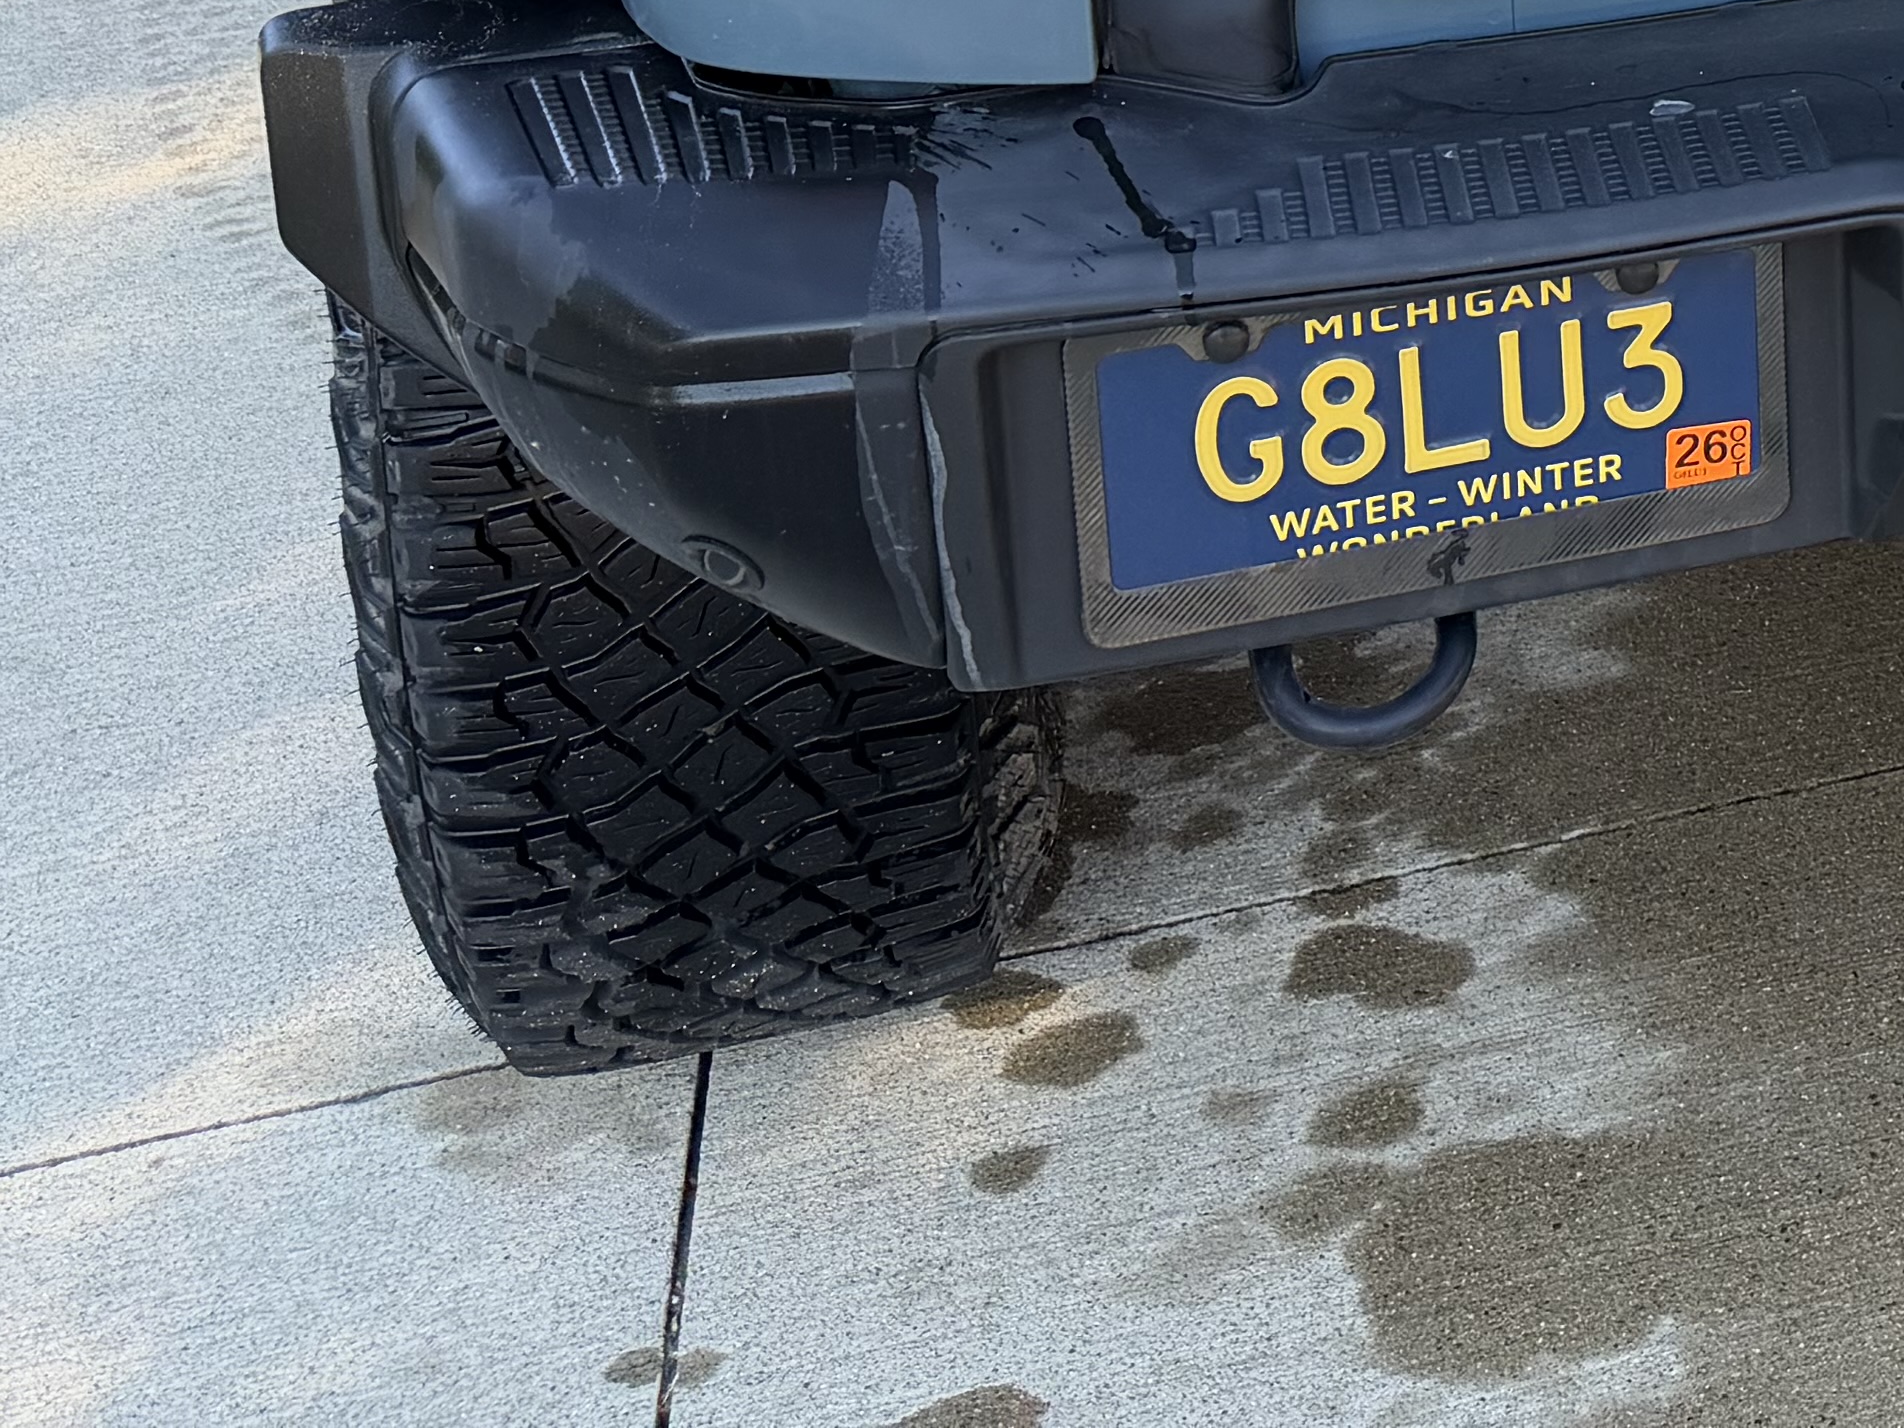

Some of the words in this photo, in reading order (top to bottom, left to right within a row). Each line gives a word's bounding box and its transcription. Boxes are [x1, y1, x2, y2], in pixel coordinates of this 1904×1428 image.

[1304, 276, 1572, 344] MICHIGAN
[1195, 302, 1683, 503] G8LU3
[1675, 429, 1728, 469] 26
[1729, 425, 1747, 476] OCT
[1270, 491, 1416, 542] WATER
[1458, 455, 1622, 507] WINTER
